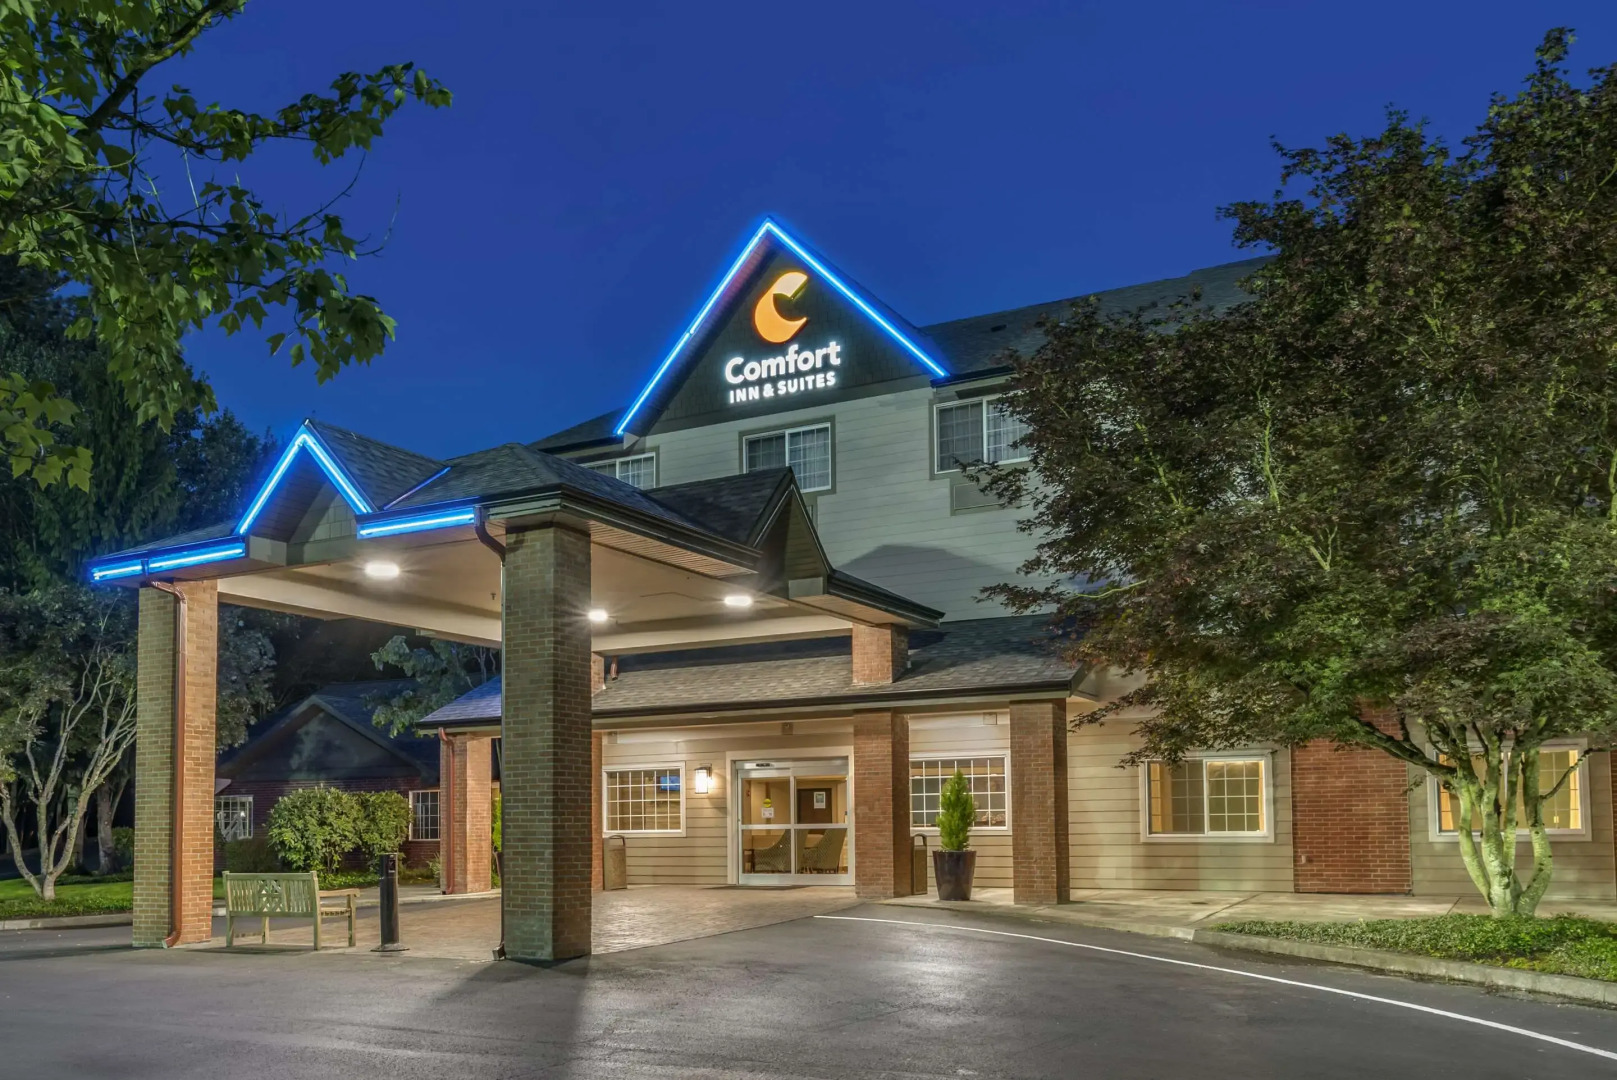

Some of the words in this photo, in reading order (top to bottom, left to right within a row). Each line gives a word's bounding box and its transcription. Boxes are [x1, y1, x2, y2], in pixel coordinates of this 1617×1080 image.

[725, 341, 841, 384] Comfort
[730, 386, 760, 404] INN
[763, 383, 775, 398] &
[777, 371, 836, 395] SUITES
